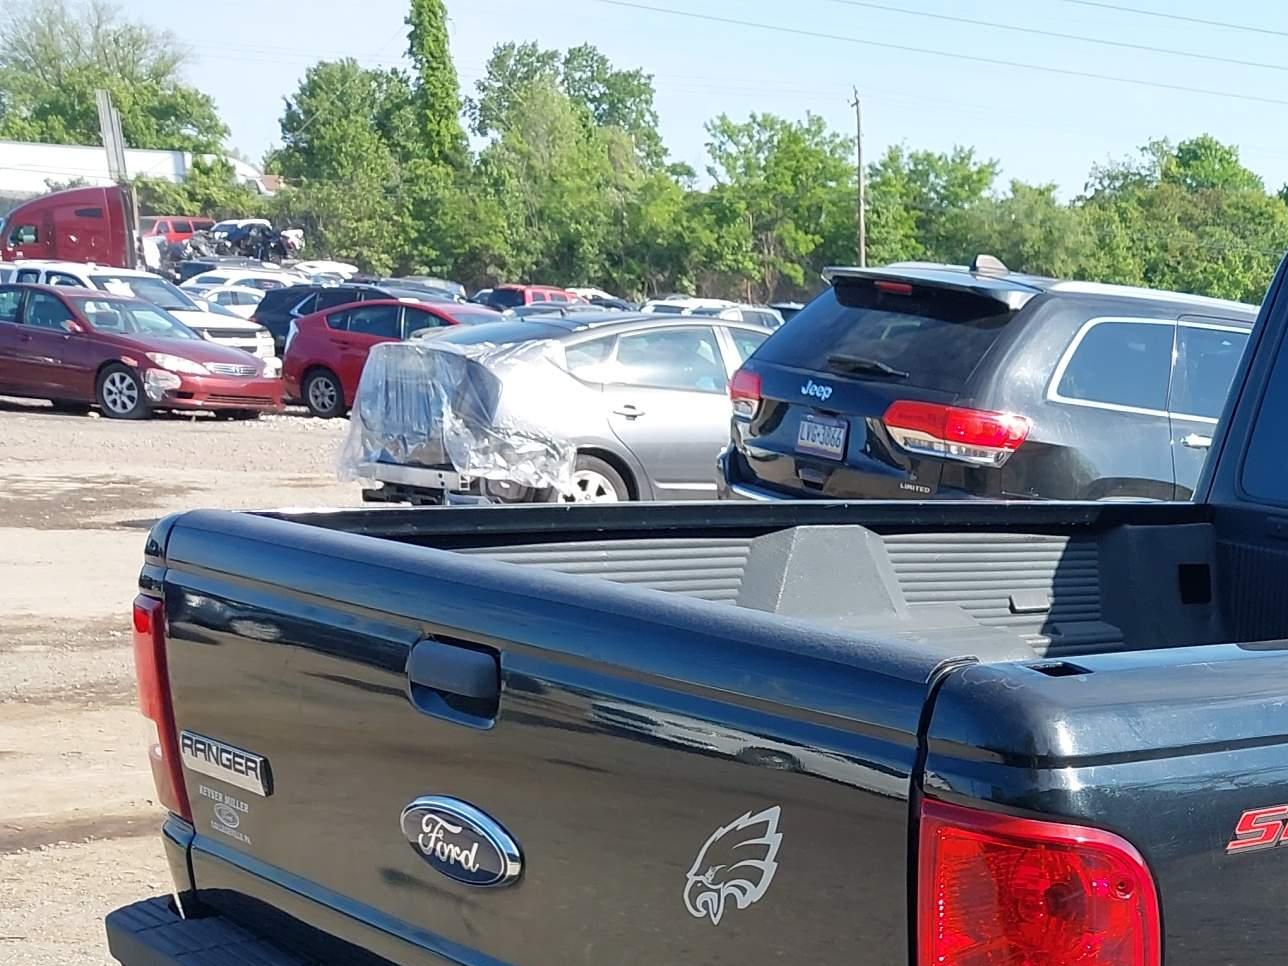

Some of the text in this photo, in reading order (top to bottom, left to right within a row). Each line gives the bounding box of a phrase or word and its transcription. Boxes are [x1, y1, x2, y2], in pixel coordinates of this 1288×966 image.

[801, 380, 833, 401] Jeep
[900, 482, 931, 494] LIMITED
[181, 734, 259, 781] RANGER
[418, 813, 480, 873] Ford
